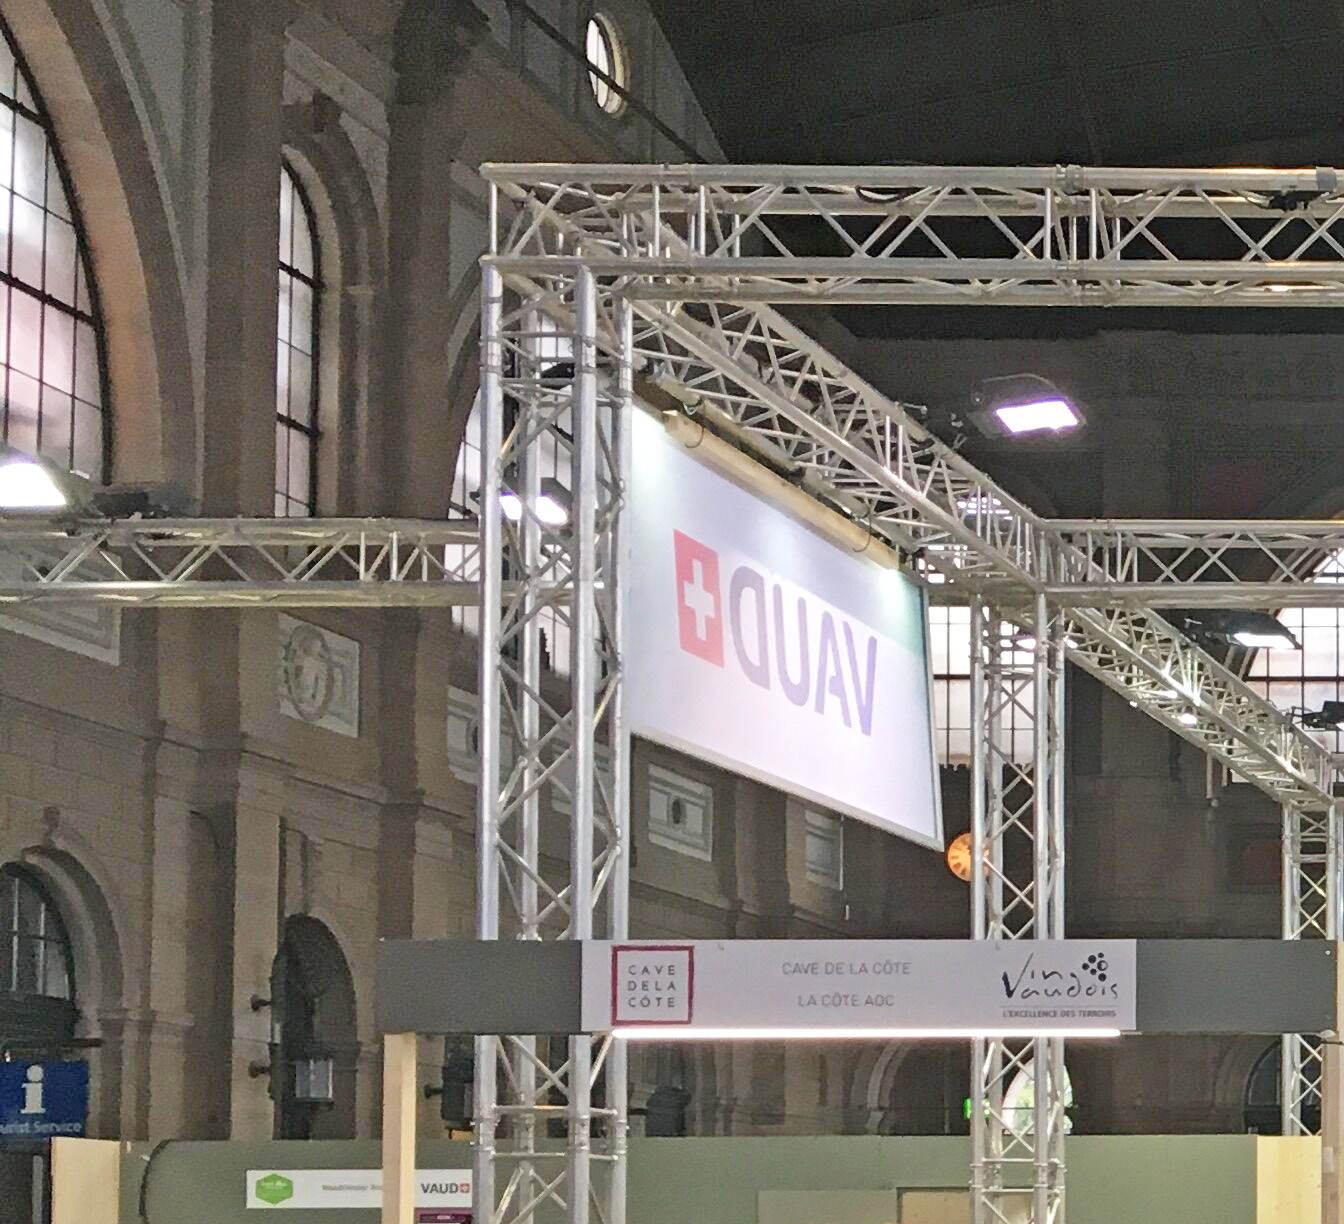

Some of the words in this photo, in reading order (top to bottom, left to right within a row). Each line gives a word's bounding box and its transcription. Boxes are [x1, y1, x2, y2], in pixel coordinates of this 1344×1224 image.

[628, 964, 675, 976] CAVE
[782, 962, 819, 976] CAVE
[825, 962, 845, 975] DE
[850, 962, 868, 975] LA
[873, 959, 912, 975] CÔTE
[628, 995, 675, 1008] CÔTE
[798, 995, 819, 1007] LA
[822, 992, 859, 1007] CÔTE
[864, 994, 894, 1007] AOC
[421, 1183, 460, 1194] VAUD
